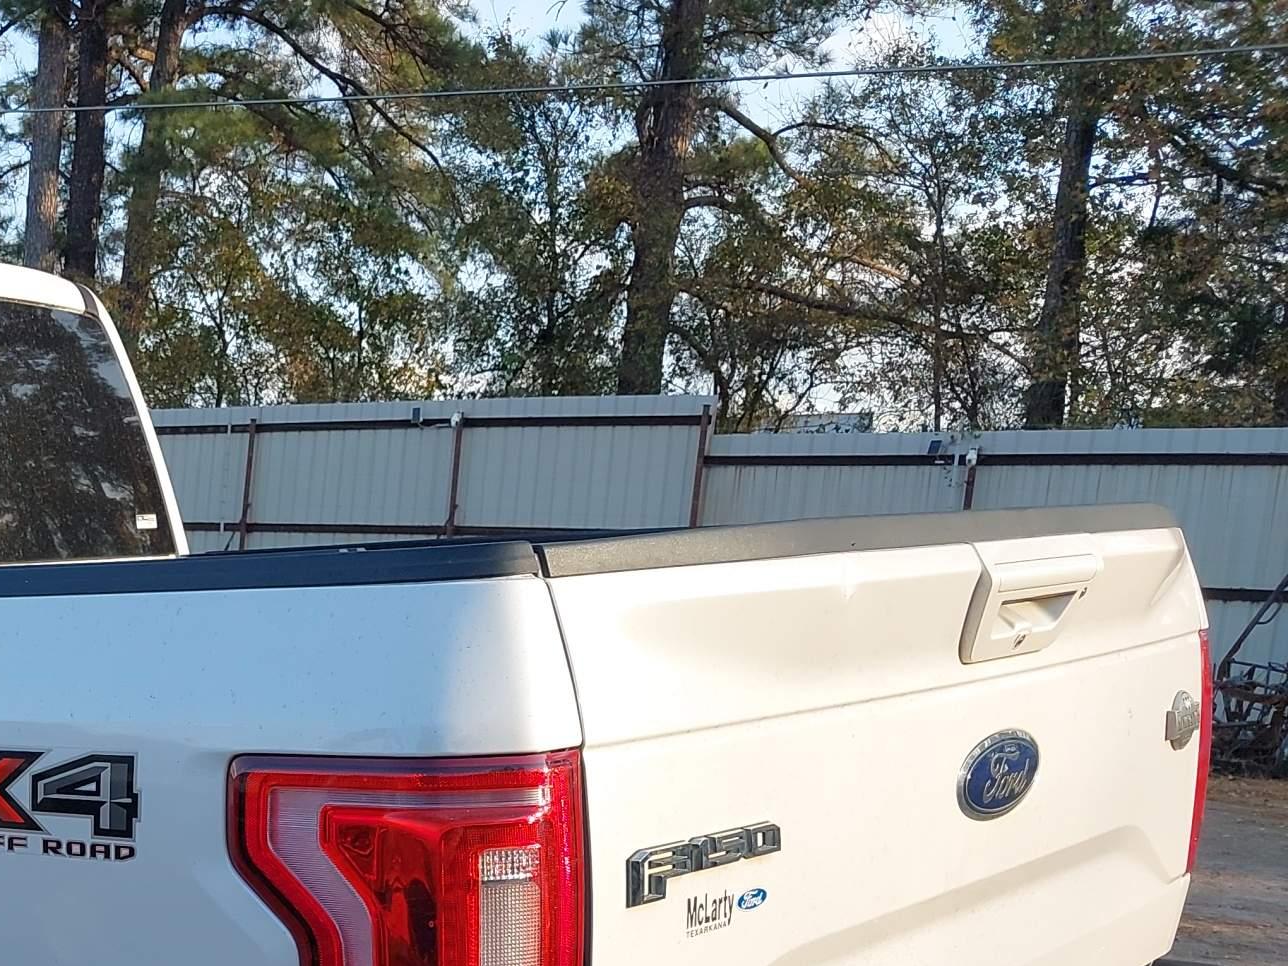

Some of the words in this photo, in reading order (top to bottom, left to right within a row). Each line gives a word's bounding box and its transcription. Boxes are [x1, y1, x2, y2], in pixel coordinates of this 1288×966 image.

[982, 743, 1031, 804] Ford
[41, 838, 137, 863] ROAD
[686, 888, 734, 930] McLarty
[740, 888, 765, 909] Ford
[685, 920, 728, 939] TEXARKANA
